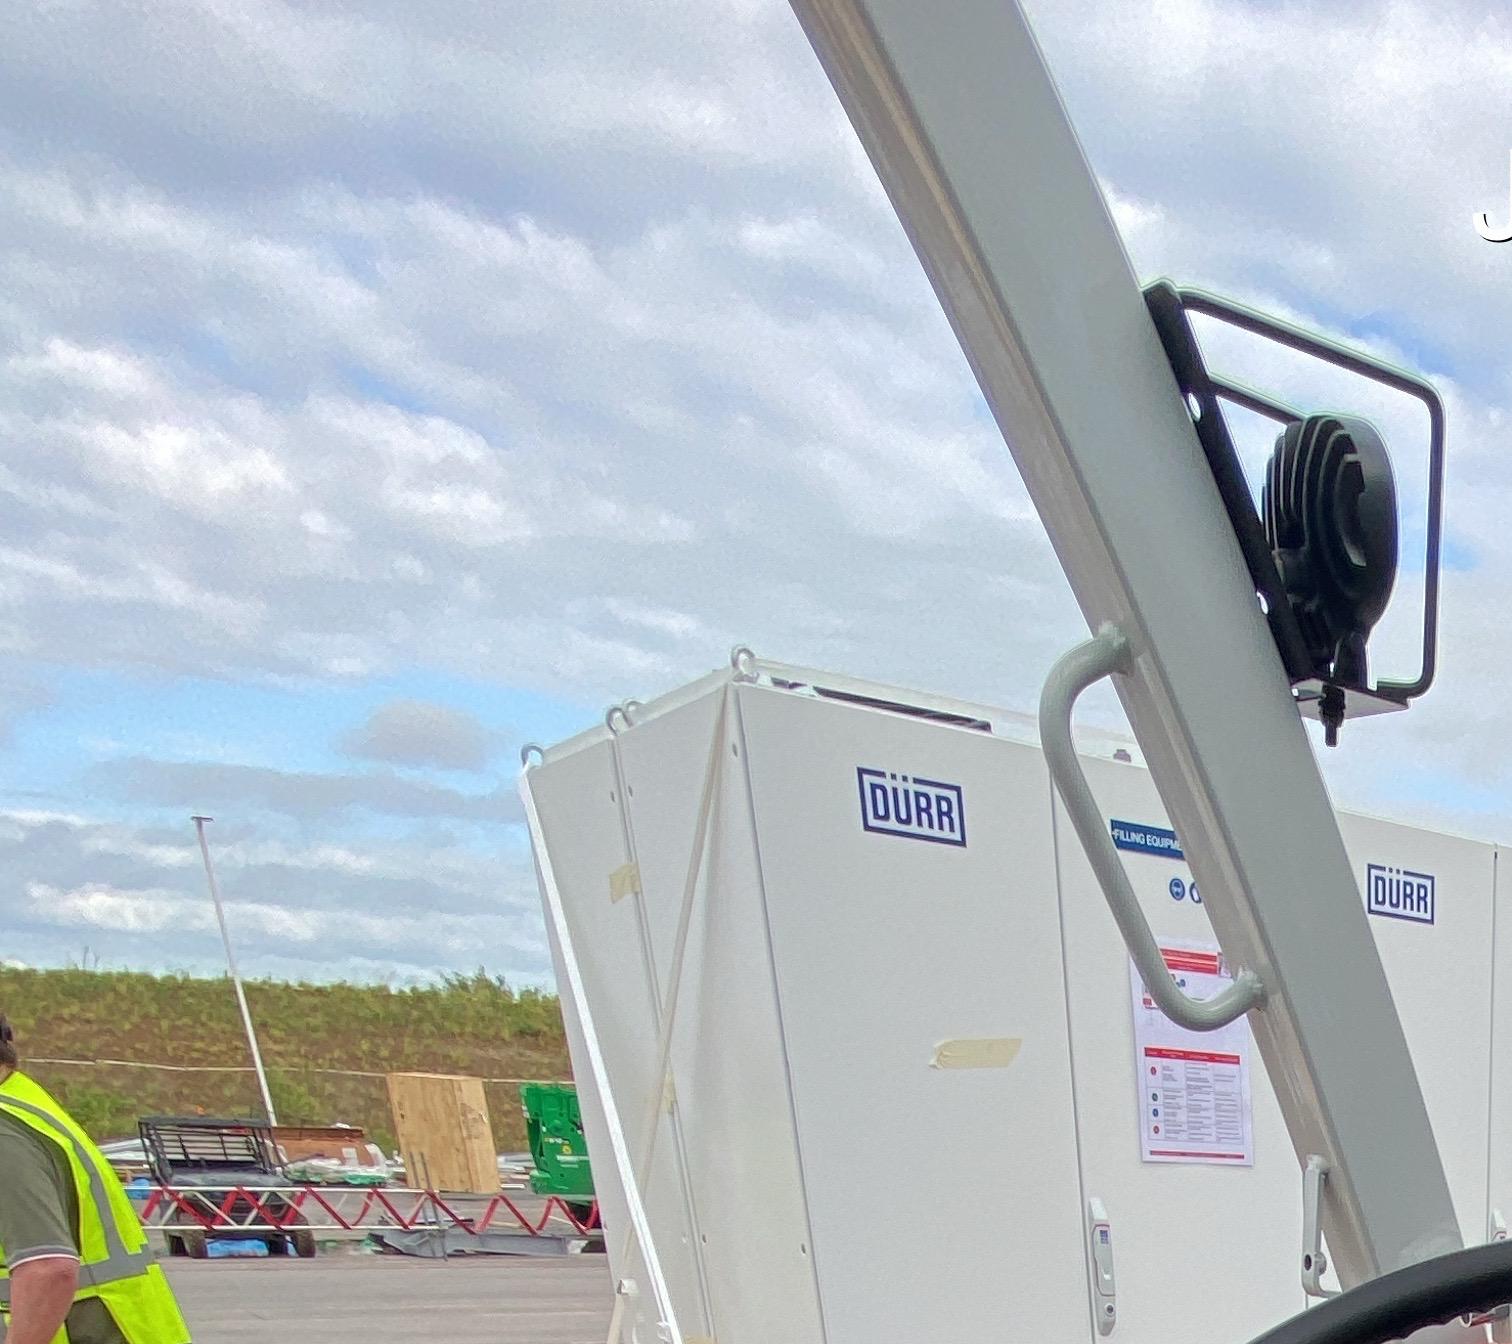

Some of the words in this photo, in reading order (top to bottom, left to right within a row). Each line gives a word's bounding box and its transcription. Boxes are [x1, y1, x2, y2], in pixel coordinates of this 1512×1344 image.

[869, 772, 956, 834] DÜRR
[1114, 828, 1145, 847] FILLING
[1146, 834, 1181, 850] EQUIPM
[1374, 867, 1428, 914] DÜRR
